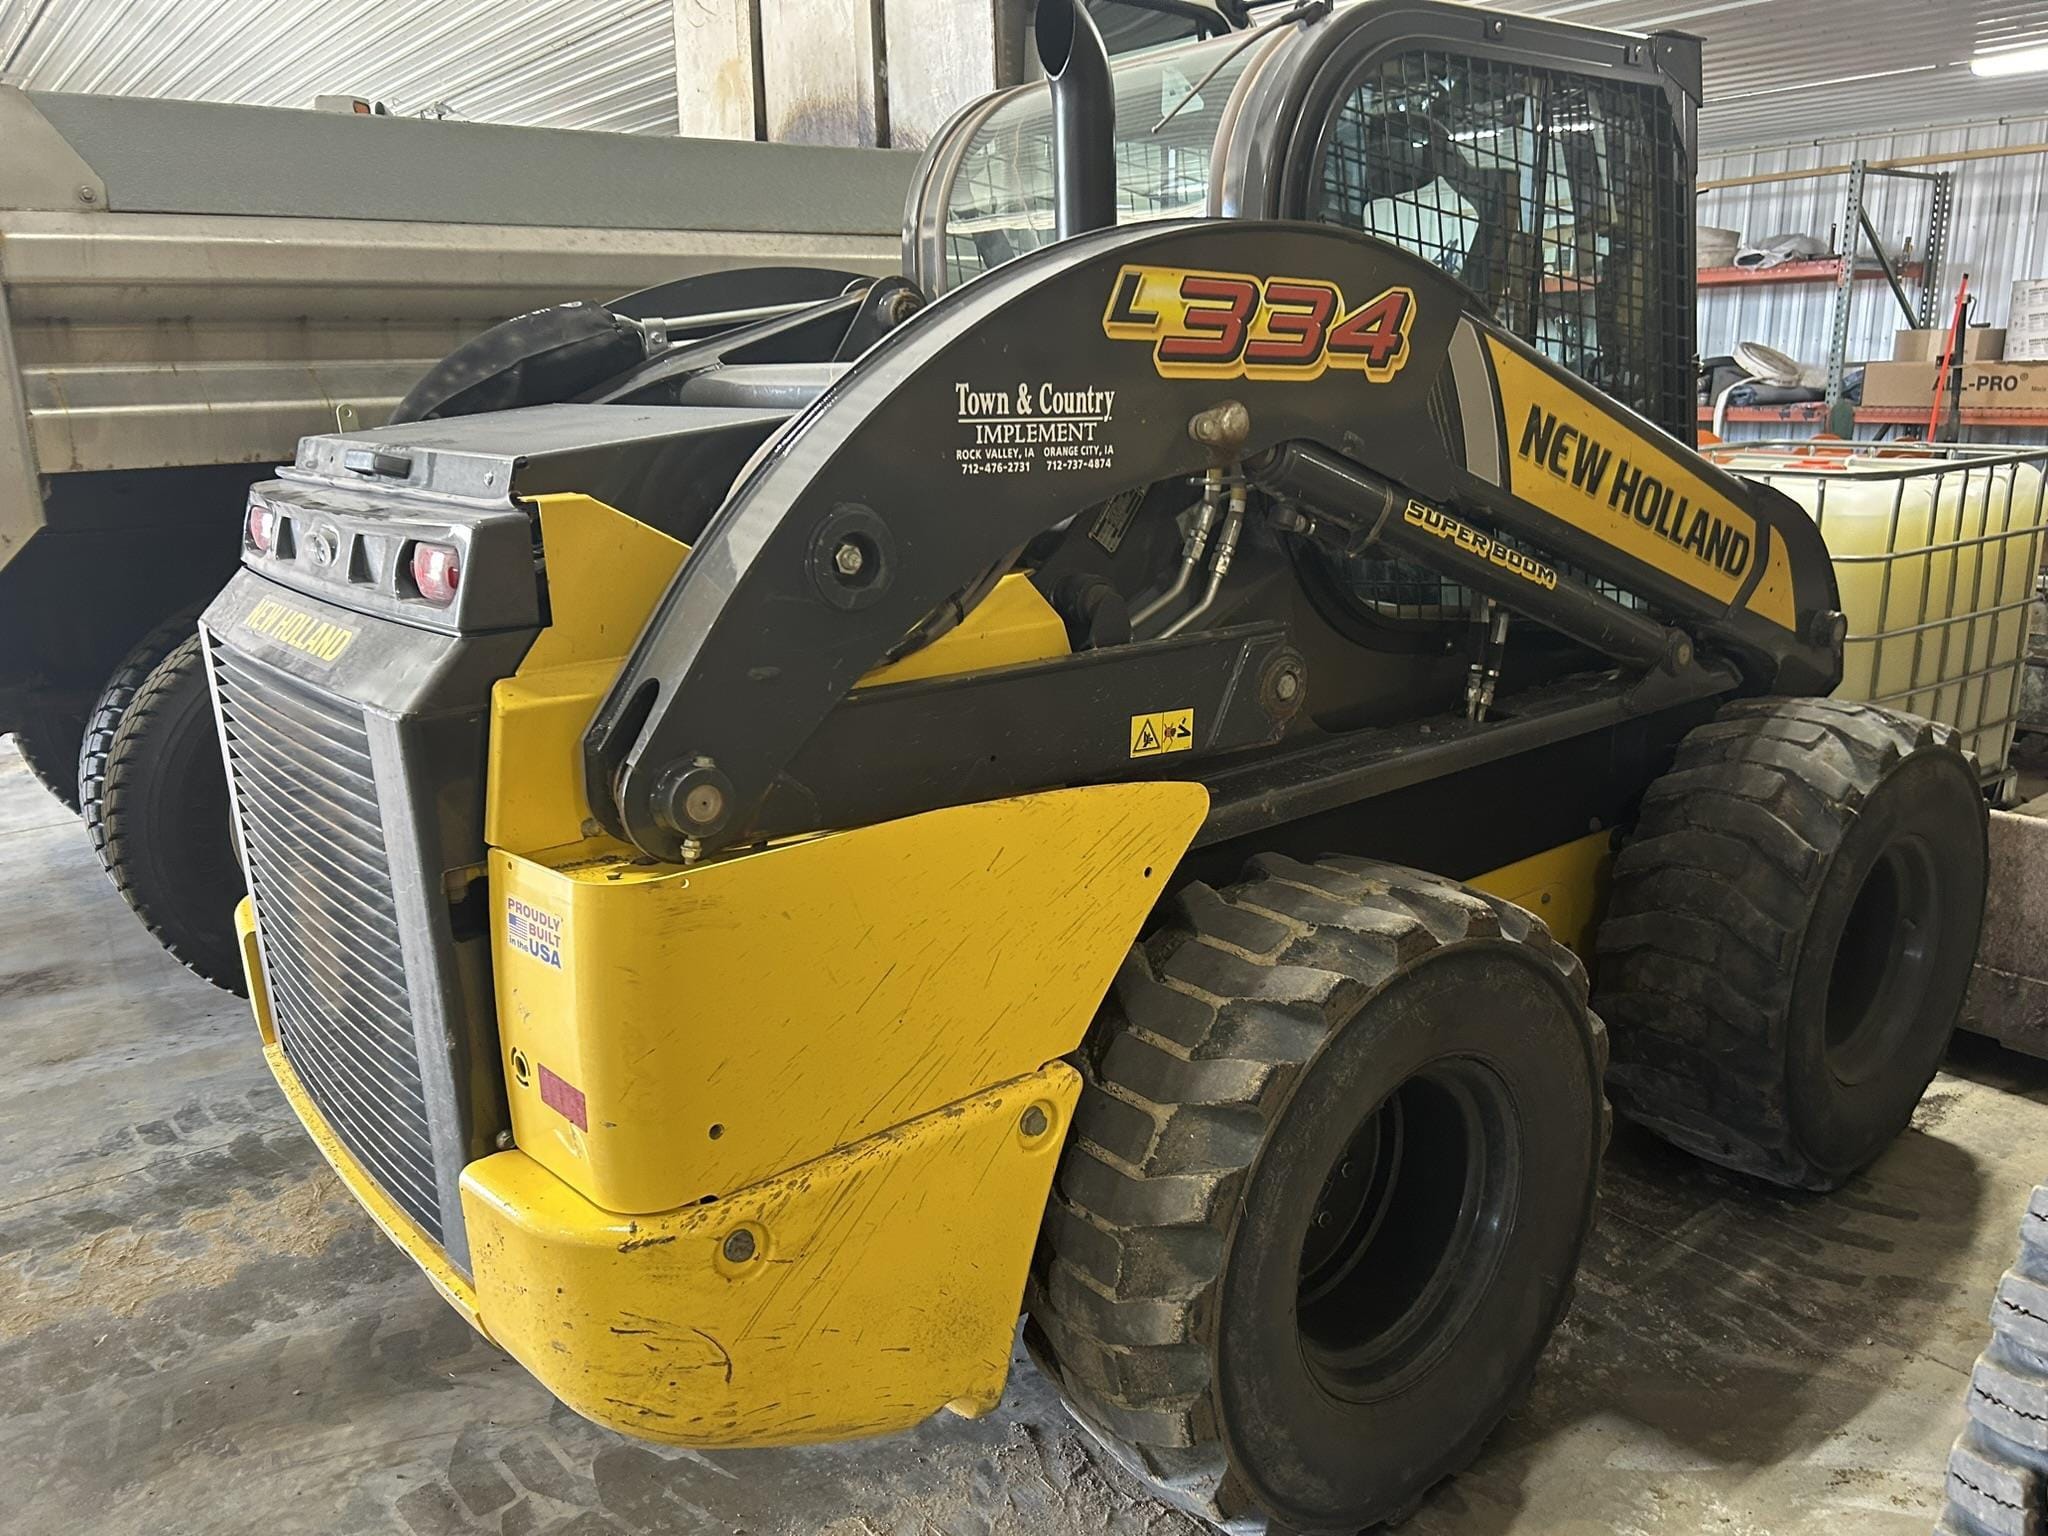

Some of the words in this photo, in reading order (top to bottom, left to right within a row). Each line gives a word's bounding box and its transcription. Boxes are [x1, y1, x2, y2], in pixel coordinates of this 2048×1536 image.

[1105, 268, 1413, 378] L334
[956, 382, 1009, 415] Town
[1016, 382, 1032, 415] &
[1039, 382, 1115, 422] Country
[975, 422, 1097, 444] IMPLEMENT
[956, 449, 981, 460] ROCK
[985, 447, 1022, 459] VALLEY,
[1024, 447, 1035, 458] IA
[1043, 447, 1078, 457] ORANGE
[1080, 446, 1102, 457] CITY,
[1104, 445, 1114, 455] IA
[1046, 458, 1112, 471] 712-737-4874
[962, 462, 1030, 475] 712-476-2731
[1518, 403, 1612, 498] NEW
[1607, 457, 1752, 580] HOLLAND
[243, 598, 288, 634] NEW
[269, 608, 353, 662] HOLLAND
[508, 898, 560, 932] PROUDLY
[528, 922, 561, 948] BUILT
[529, 938, 562, 969] USA
